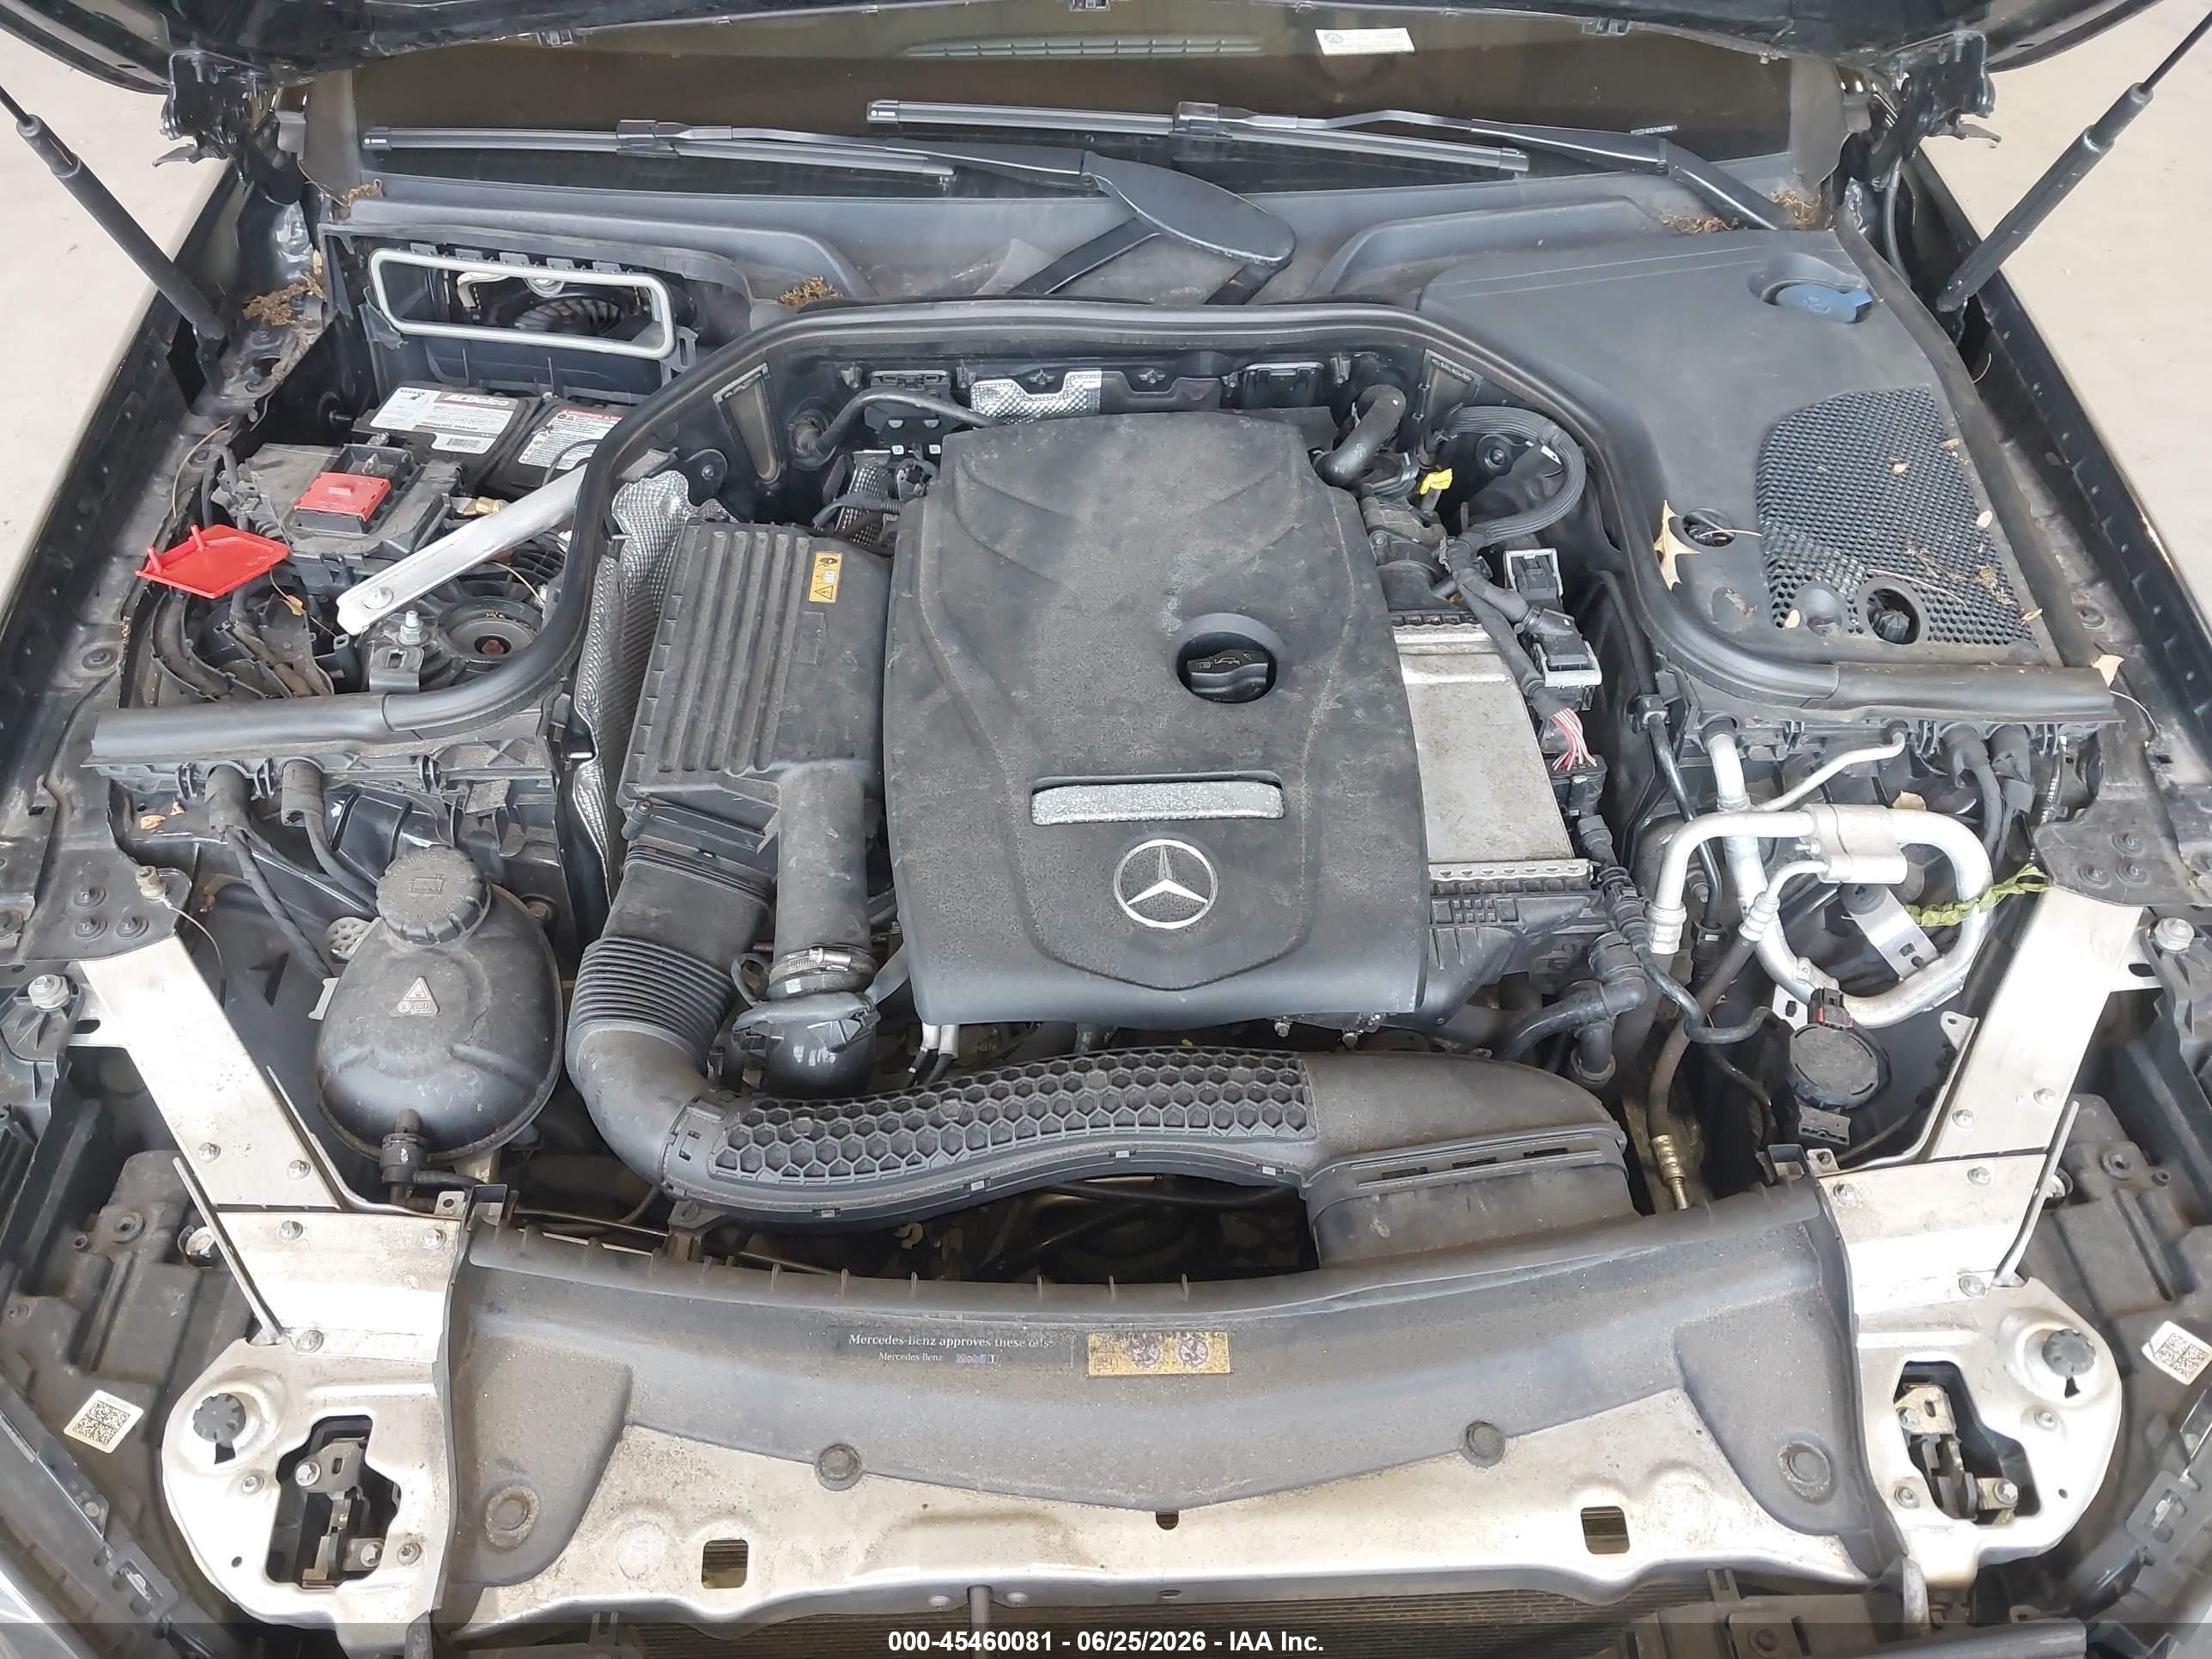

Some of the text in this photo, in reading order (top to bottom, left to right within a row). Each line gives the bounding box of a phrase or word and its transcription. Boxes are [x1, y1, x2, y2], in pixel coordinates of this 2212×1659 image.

[444, 394, 510, 407] ACDelco
[848, 1334, 938, 1346] Mercedes-Benz
[939, 1336, 991, 1348] approves
[994, 1338, 1025, 1348] these
